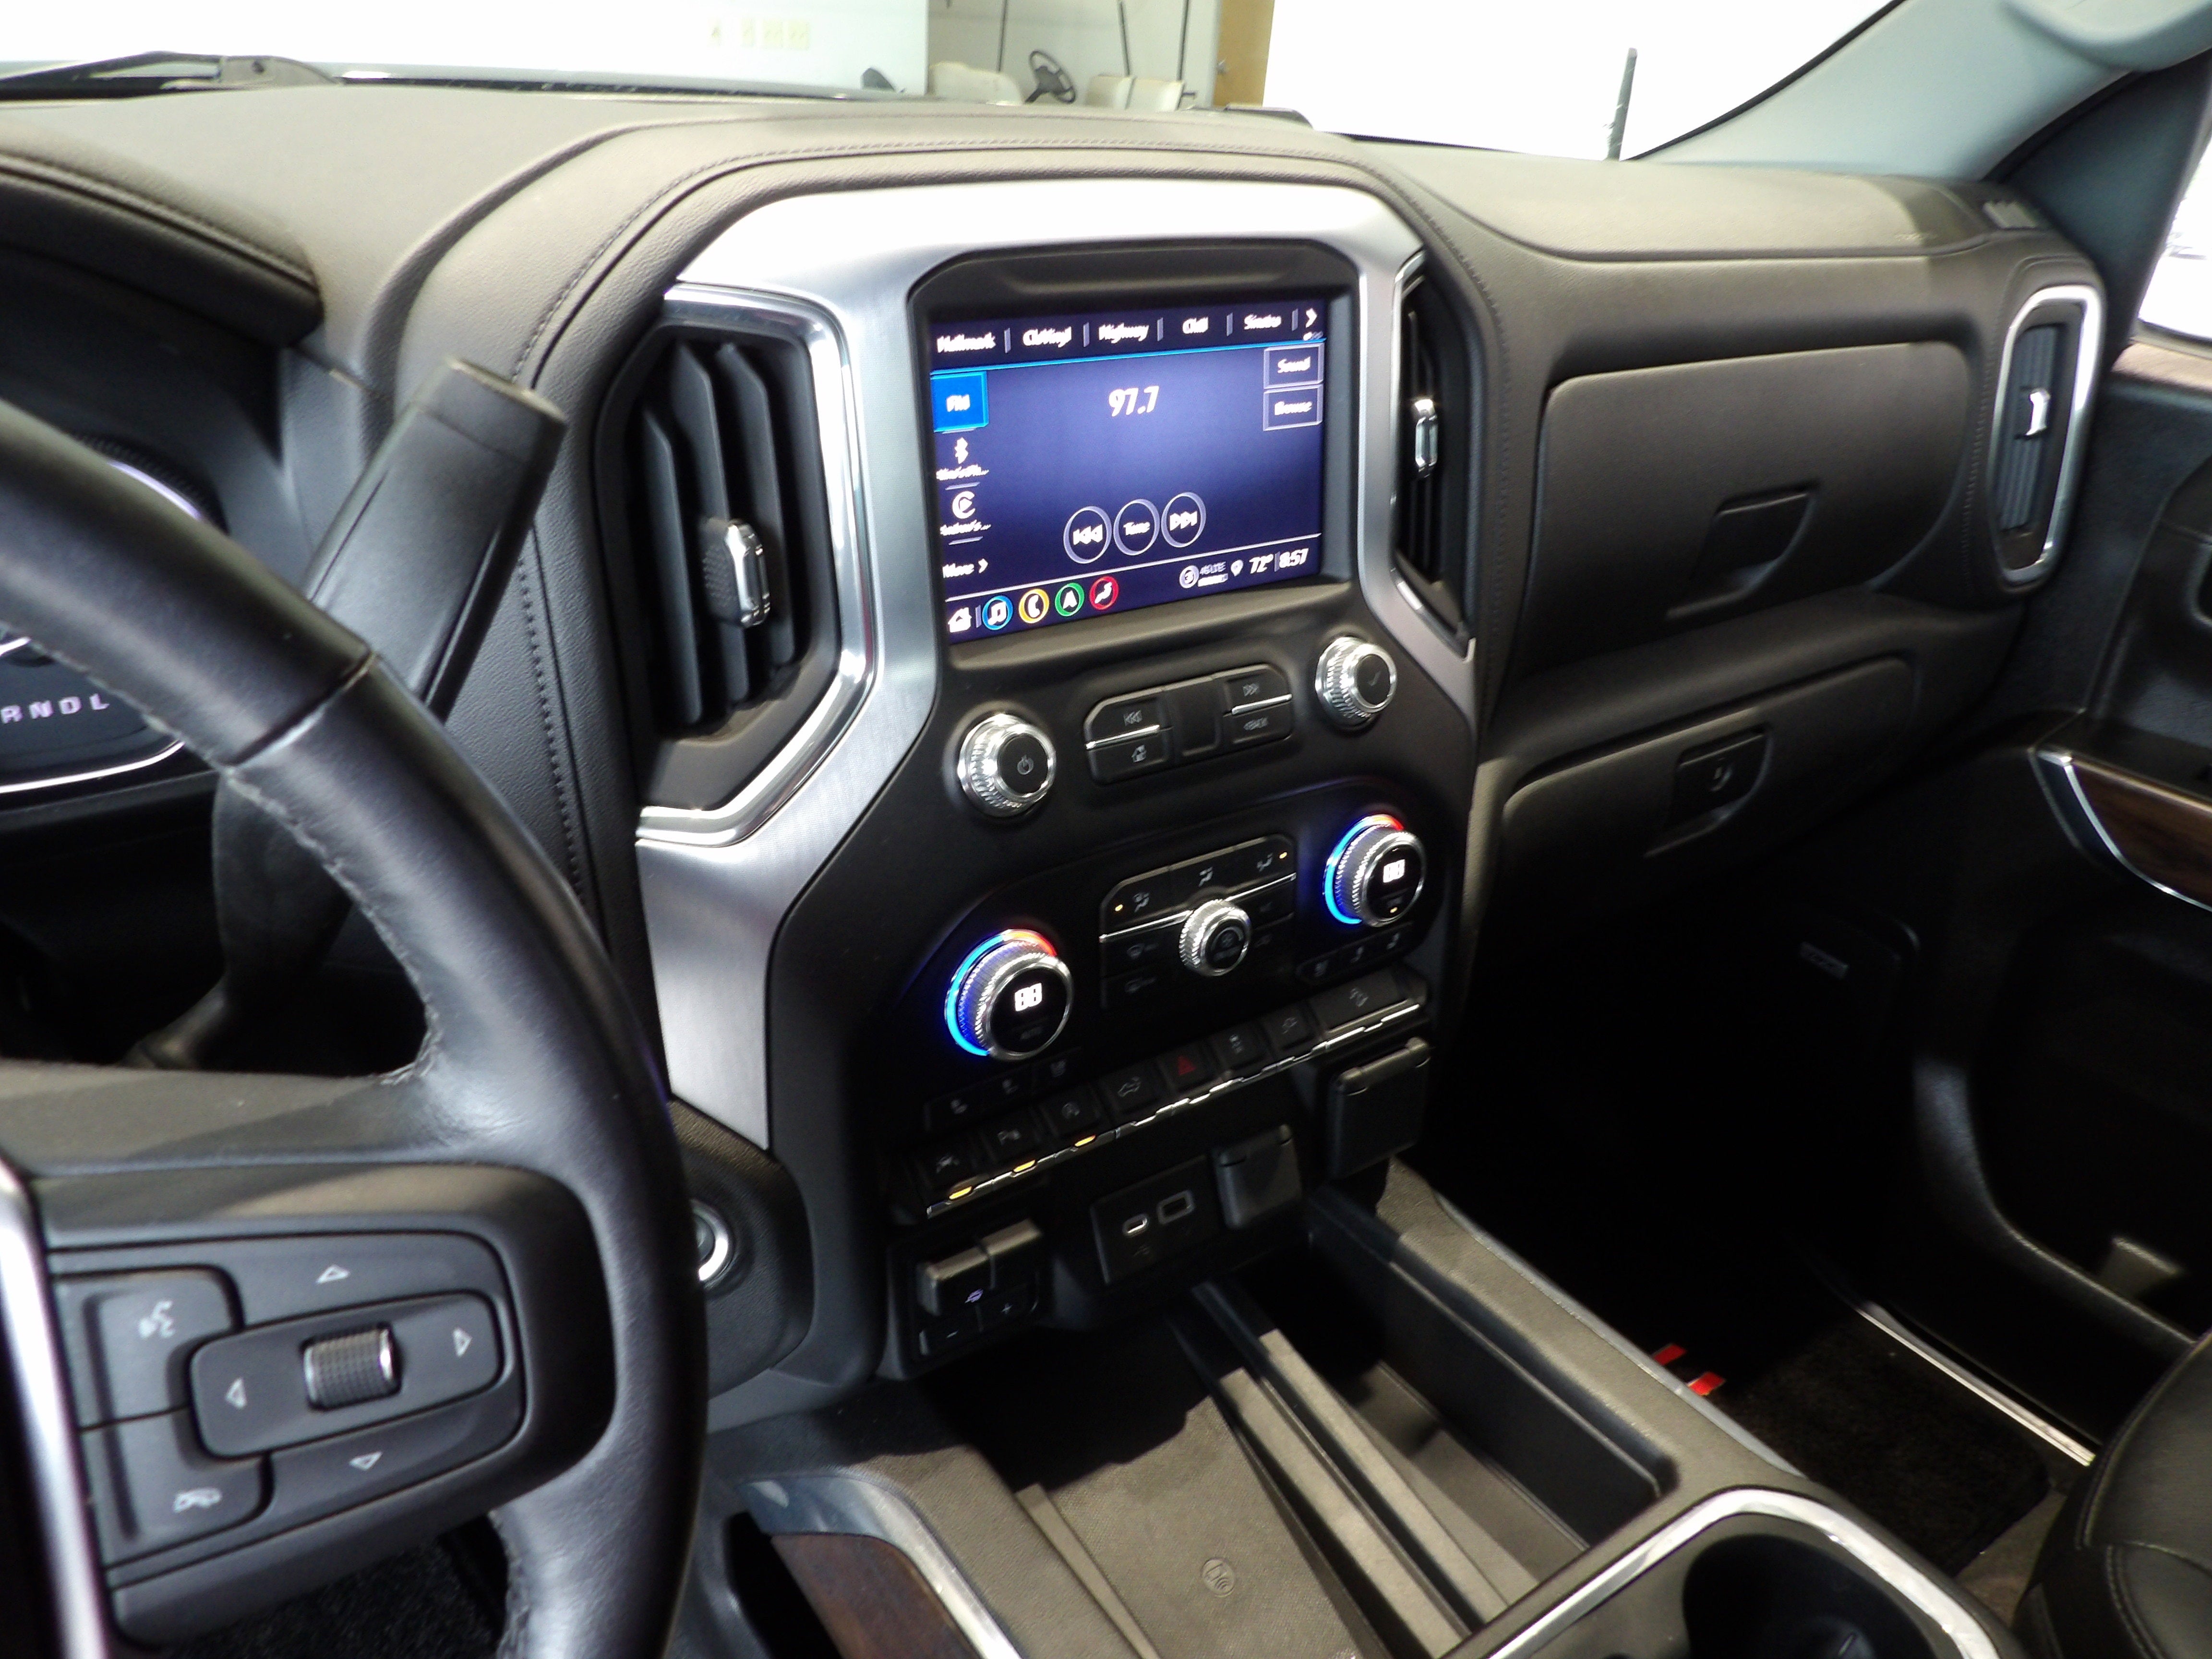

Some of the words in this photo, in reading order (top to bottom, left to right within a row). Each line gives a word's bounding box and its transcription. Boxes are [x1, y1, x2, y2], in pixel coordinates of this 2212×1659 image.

[947, 395, 970, 412] FM
[1109, 385, 1159, 417] 97.7
[1123, 522, 1150, 535] Tune
[943, 563, 974, 578] More
